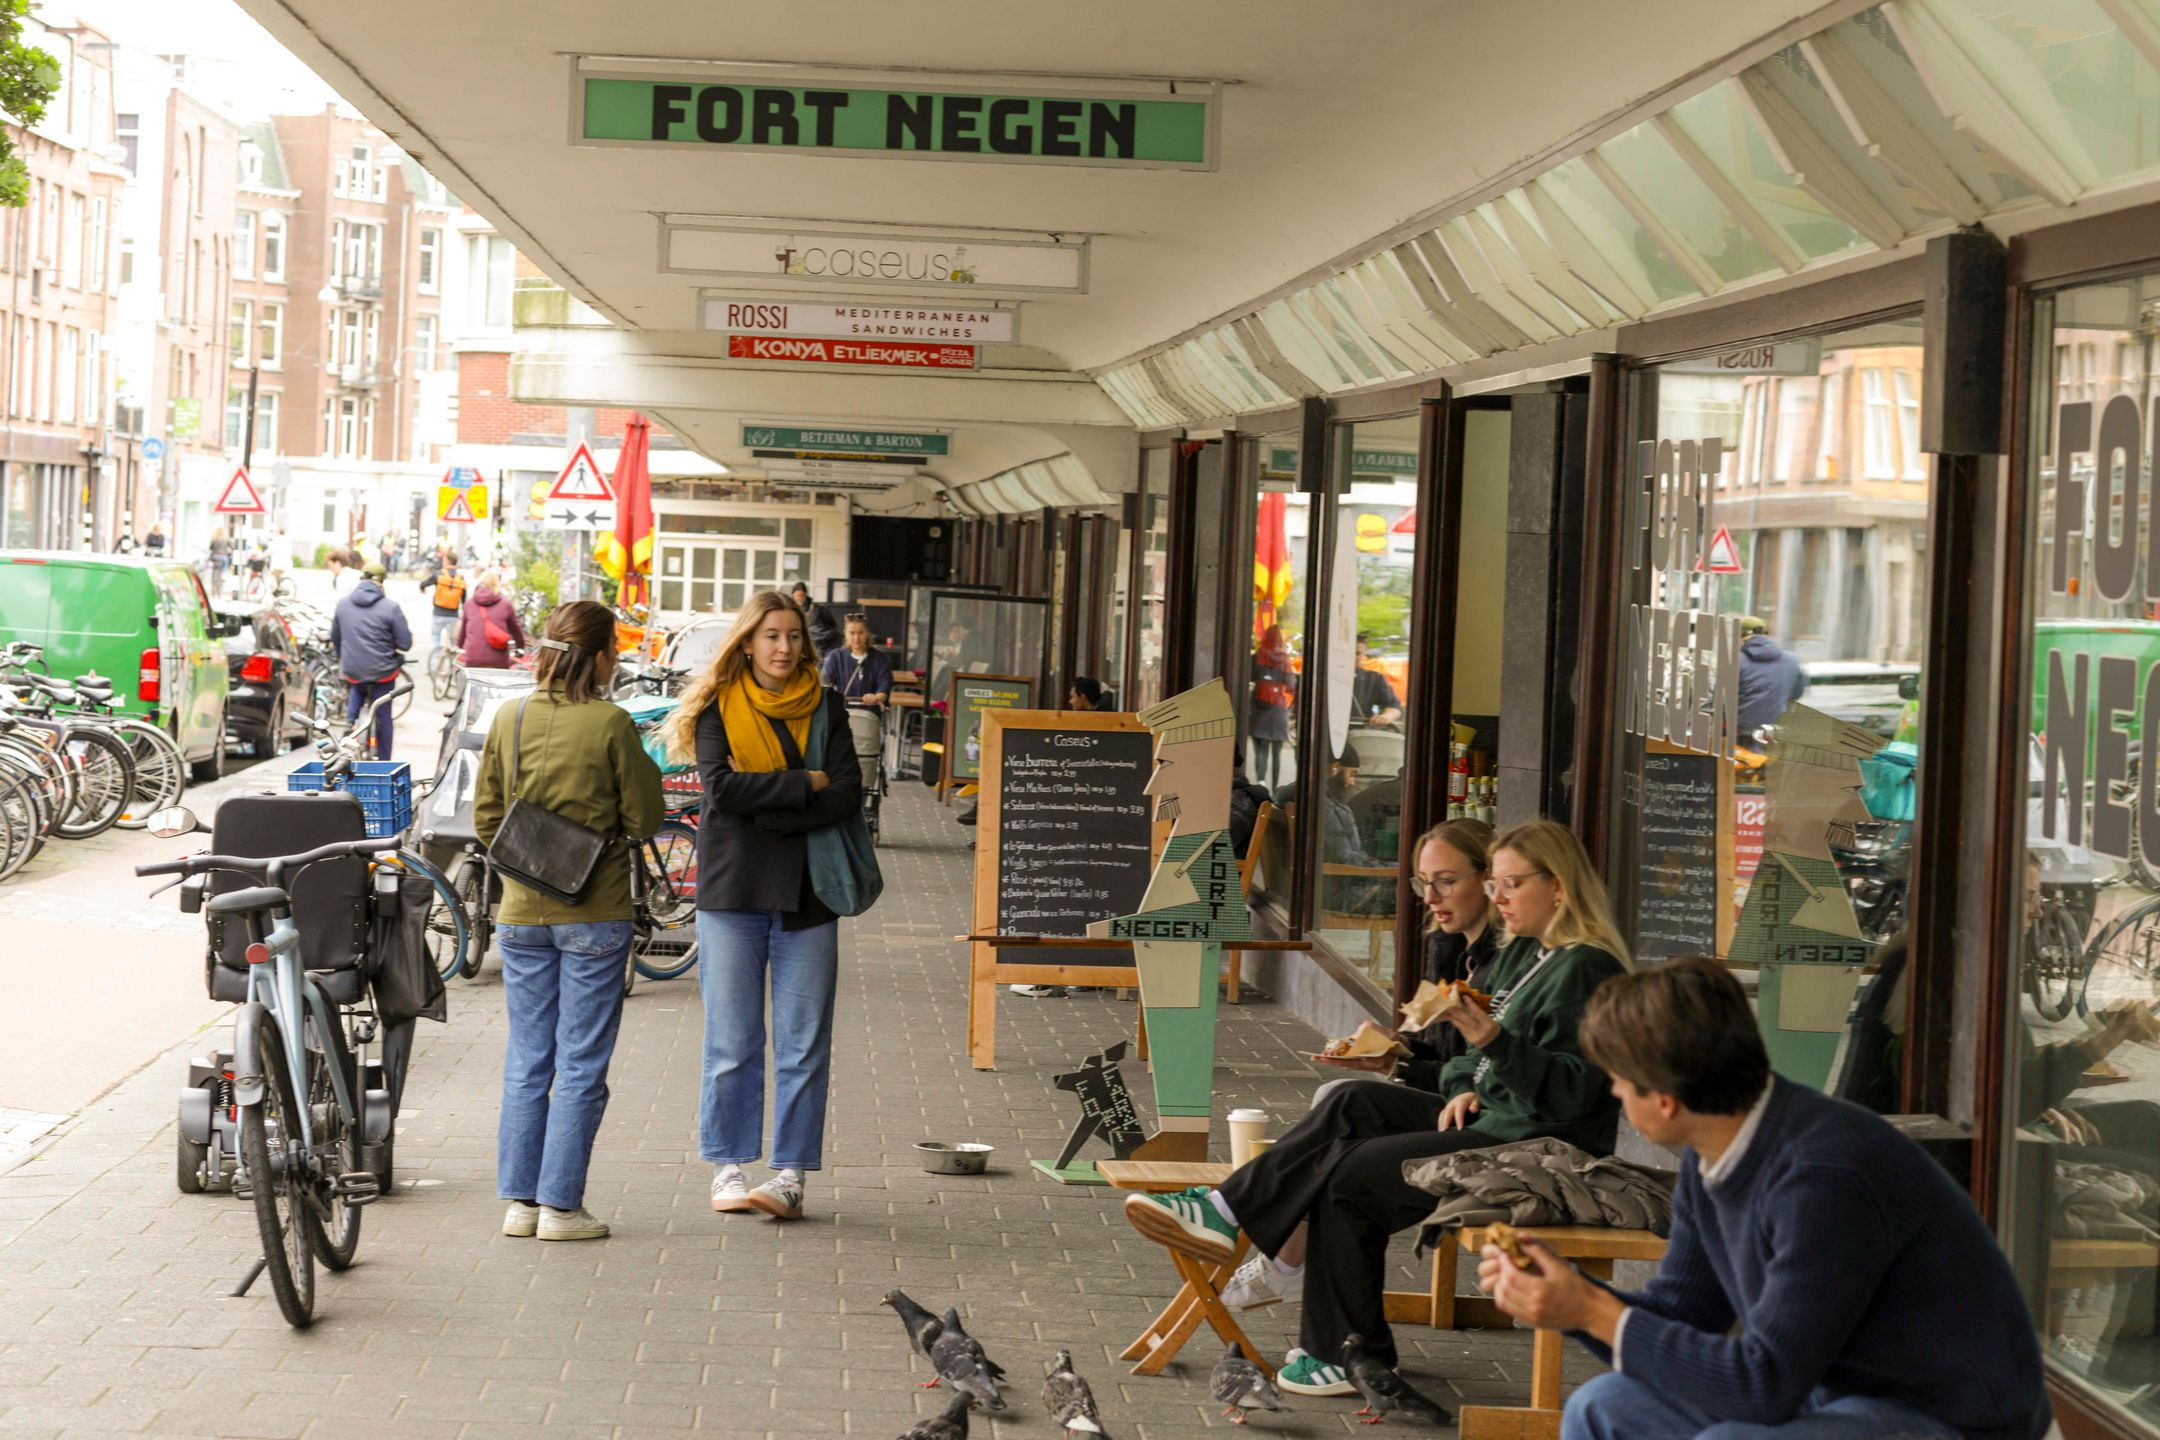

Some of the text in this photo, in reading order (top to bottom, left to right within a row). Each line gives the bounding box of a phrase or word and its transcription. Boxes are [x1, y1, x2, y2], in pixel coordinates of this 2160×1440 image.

[651, 85, 1137, 158] FORT NEGEN
[803, 247, 950, 281] caseus
[728, 304, 788, 330] ROSSI
[835, 308, 991, 324] MEDITERRANEAN
[851, 324, 973, 338] SANDWICHES
[753, 339, 829, 361] KONYA
[800, 431, 861, 445] BETJEMAN
[863, 435, 873, 446] &
[876, 434, 924, 448] BARTON
[1633, 437, 1722, 573] FORT
[1624, 604, 1742, 760] NEGEN
[1054, 734, 1091, 747] Caseus
[1210, 842, 1227, 920] FORT
[1113, 920, 1209, 938] NEGEN
